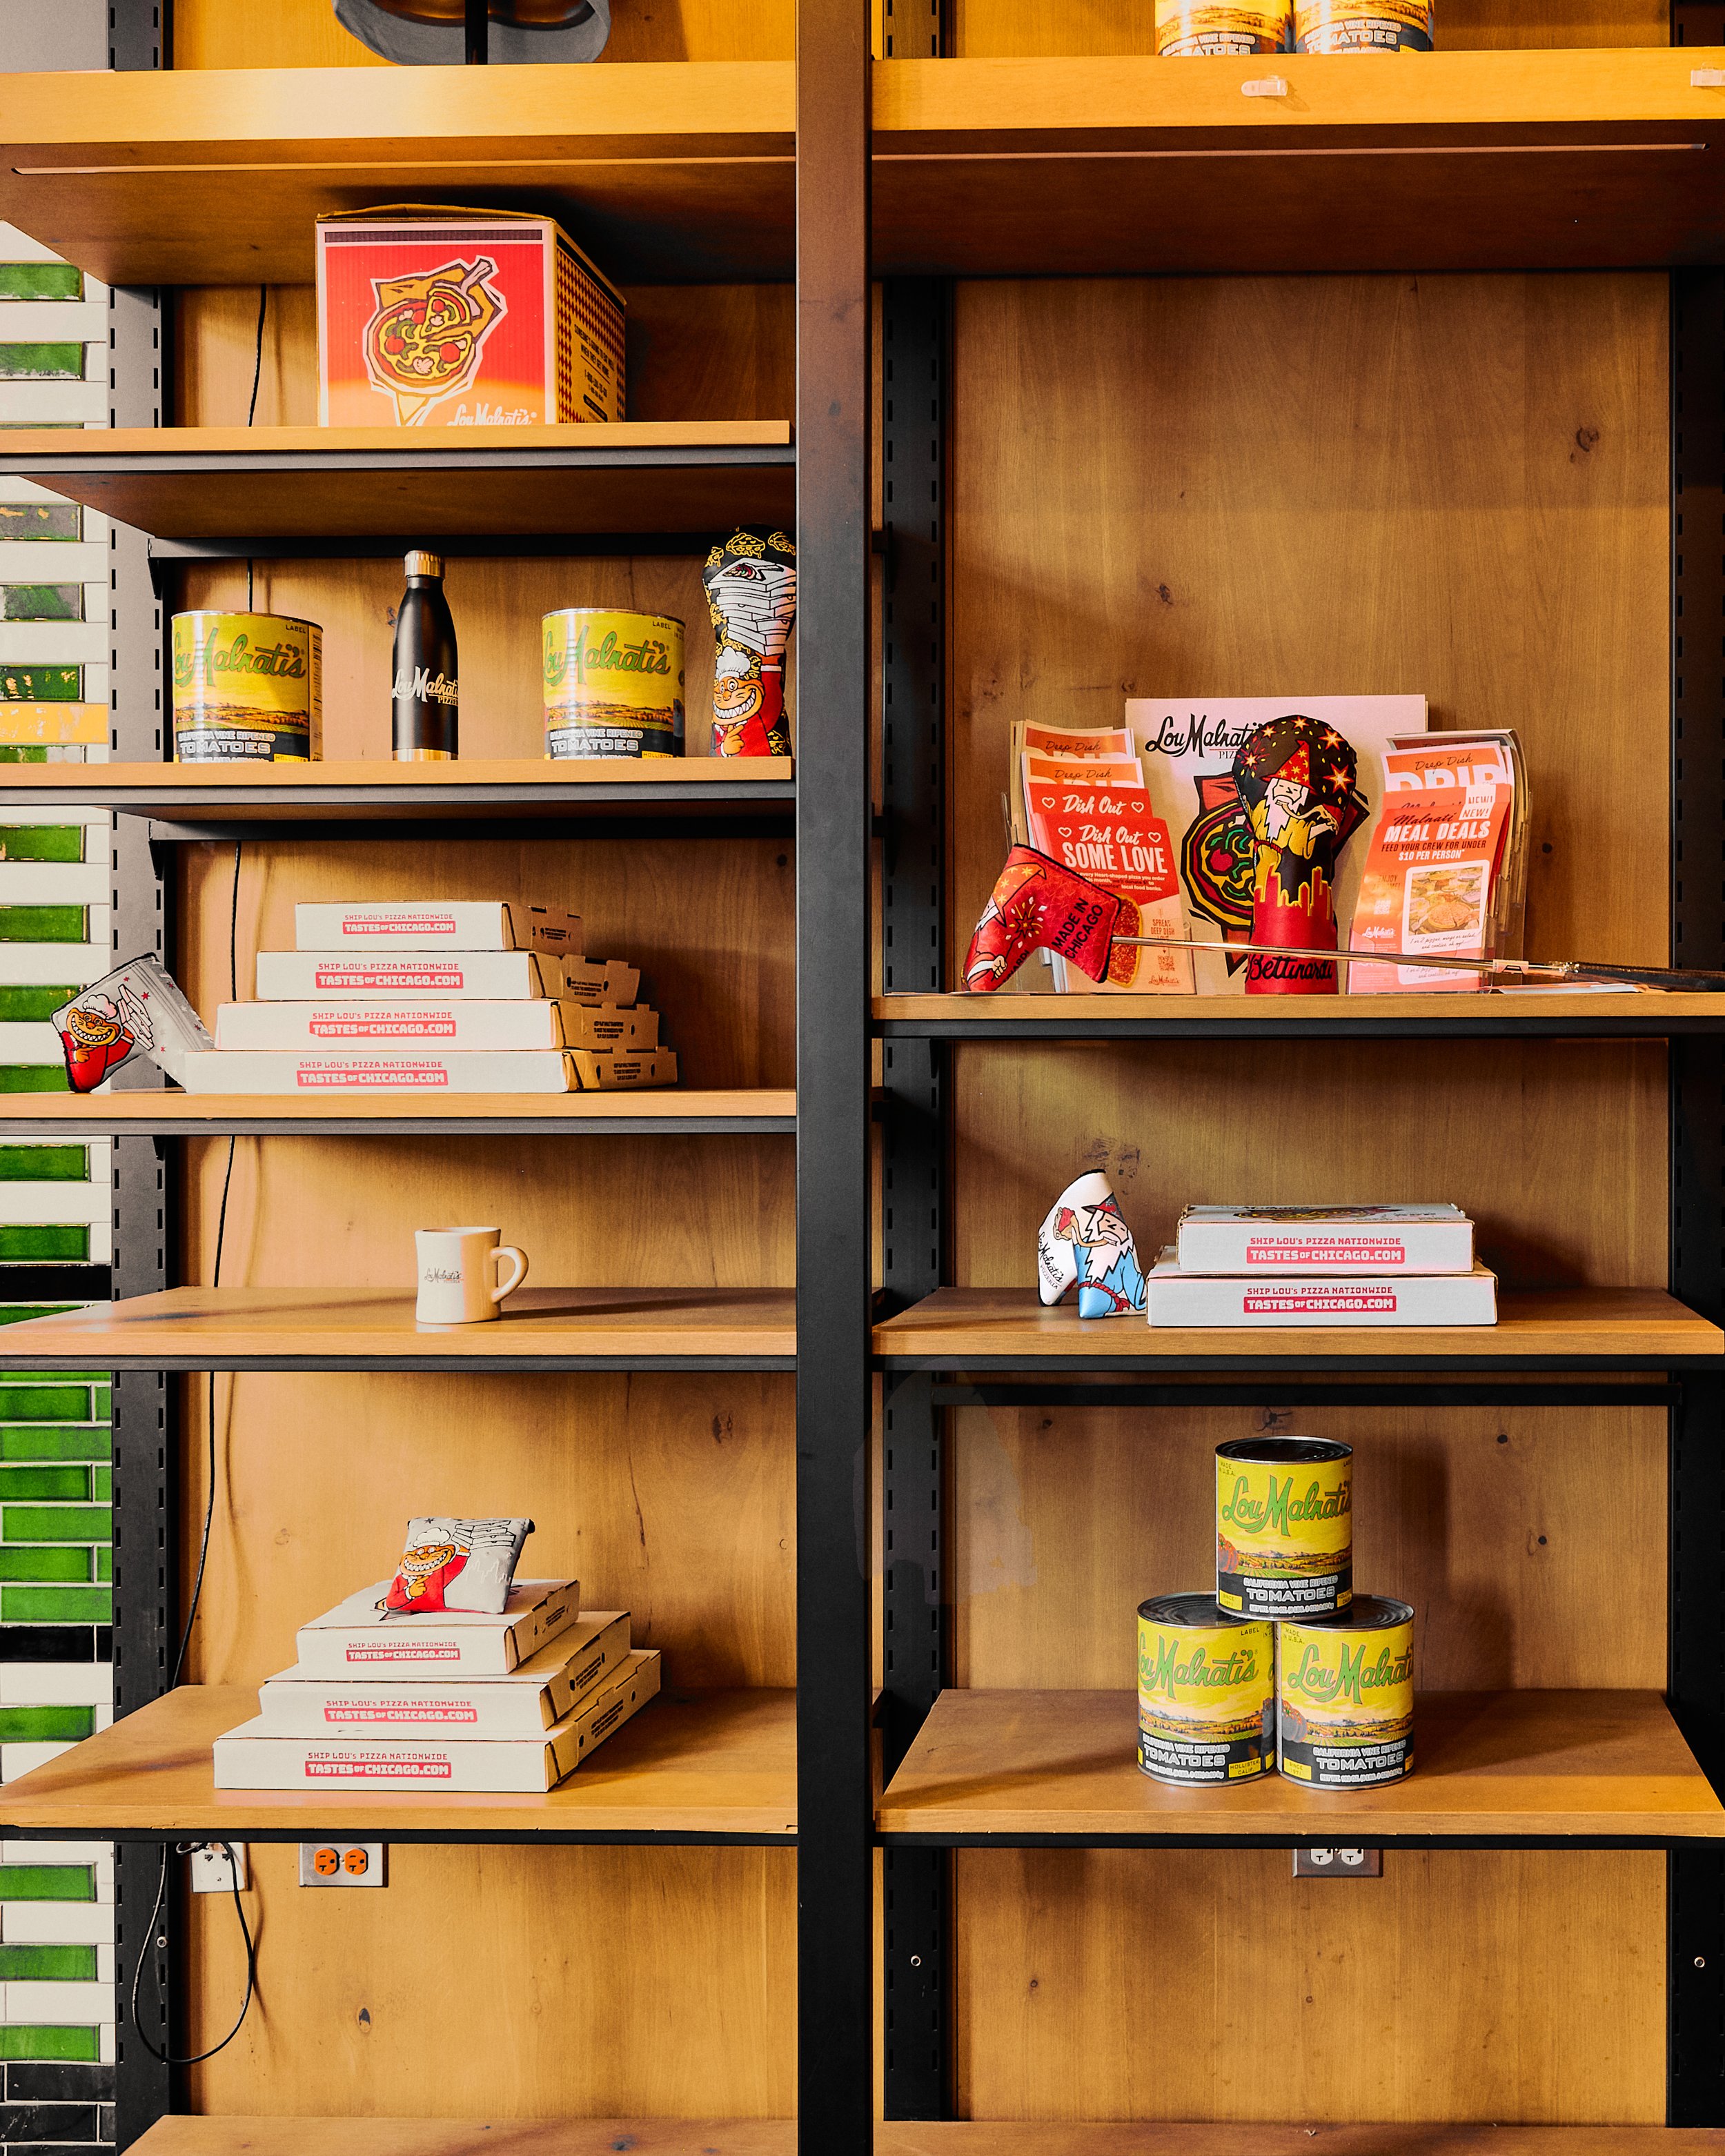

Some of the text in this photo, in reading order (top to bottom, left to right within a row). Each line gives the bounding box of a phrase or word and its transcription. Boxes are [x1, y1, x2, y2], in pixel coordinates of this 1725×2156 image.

[1345, 20, 1365, 30] VINE
[1366, 19, 1402, 32] RIPENED
[1219, 33, 1256, 45] RIPENED
[446, 402, 533, 426] Lou Malnati's
[285, 624, 306, 634] LABEL
[652, 621, 671, 630] LABEL
[562, 625, 671, 684] Malnati's
[391, 669, 413, 701] Lou
[215, 731, 236, 740] VINE
[236, 731, 276, 742] RIPENED
[586, 729, 606, 738] VINE
[607, 729, 644, 740] RIPENED
[1145, 713, 1187, 758] Lou
[180, 740, 271, 754] TOMATOES
[551, 738, 639, 753] TOMATOES
[1045, 740, 1072, 756] Deep
[1075, 740, 1101, 751] Dish
[1415, 753, 1473, 775] Deep Dish
[1054, 769, 1083, 784] Deep
[1086, 767, 1112, 778] Dish
[1063, 794, 1127, 815] Dish Out
[1462, 808, 1489, 818] NEW!
[1078, 824, 1144, 845] Dish Out
[1383, 820, 1491, 843] MEAL DEALS
[1381, 840, 1487, 852] FEED YOUR CREW FOR UNDER
[1062, 842, 1168, 873] SOME LOVE
[1398, 851, 1414, 861] $10
[1416, 851, 1430, 860] PER
[1051, 898, 1089, 949] MADE IN
[1064, 904, 1103, 959] CHICAGO
[1150, 927, 1175, 936] DEEP DISH
[1244, 953, 1334, 984] Bettinardi
[1247, 1287, 1392, 1295] SHIP LOU's PIZZA NATIONWIDE
[1222, 1476, 1263, 1534] Lou
[1243, 1574, 1339, 1589] CALIFORNIA VINE RIPENED
[1246, 1585, 1335, 1602] TOMATOES
[1241, 1628, 1259, 1636] LABEL
[1153, 1635, 1259, 1700] Malnati's
[1288, 1644, 1335, 1703] Lou
[1143, 1743, 1226, 1767] TOMATOES
[1174, 1743, 1194, 1754] VINE
[1194, 1743, 1231, 1754] RIPENED
[1312, 1739, 1406, 1758] CALIFORNIA VINE RIPENED
[1316, 1750, 1403, 1771] TOMATOES
